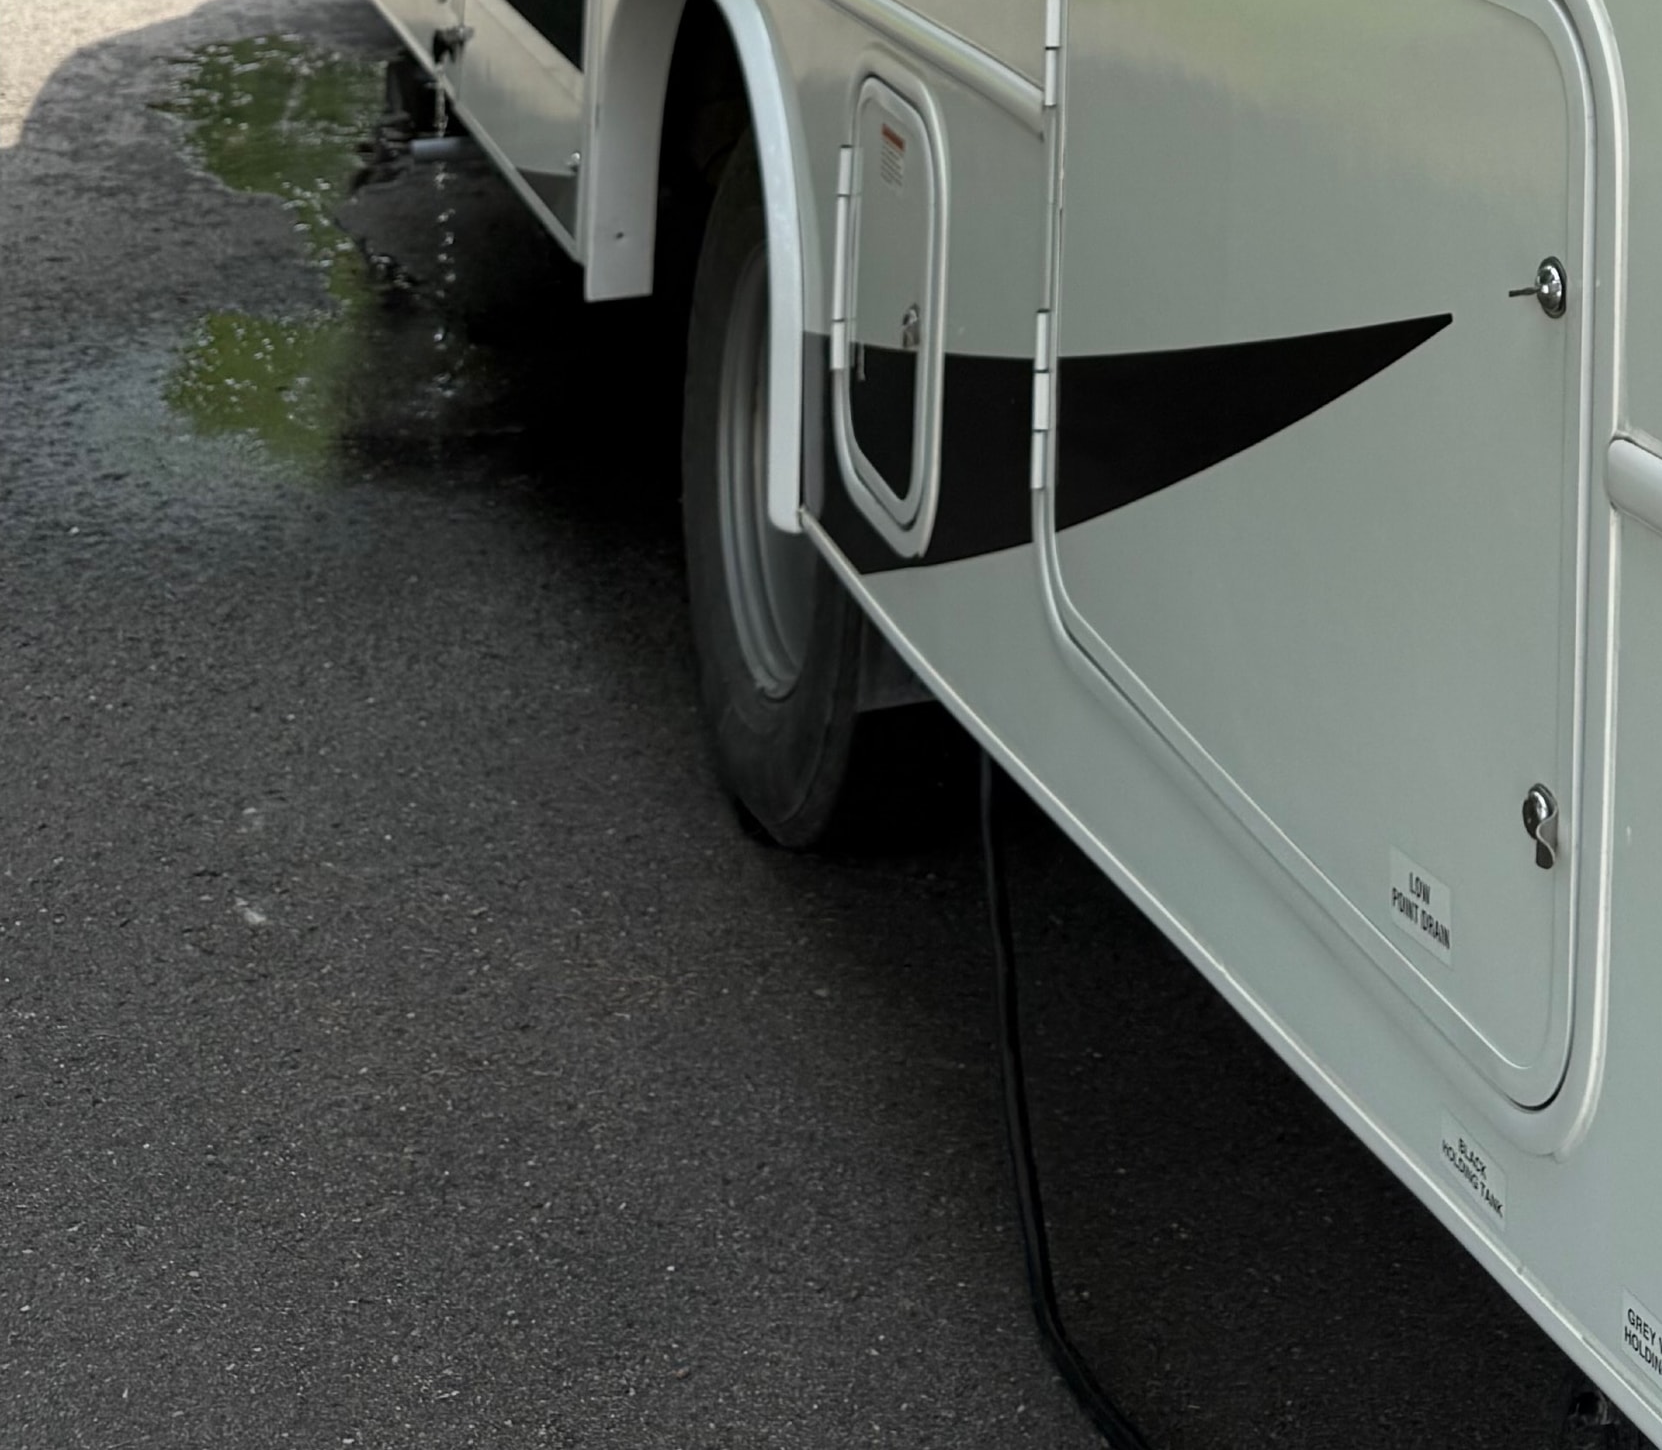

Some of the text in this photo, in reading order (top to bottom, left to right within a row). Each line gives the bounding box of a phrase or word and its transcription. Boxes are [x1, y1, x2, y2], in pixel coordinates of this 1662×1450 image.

[1409, 872, 1430, 905] LOW
[1392, 887, 1450, 949] POINT DRAIN
[1442, 1140, 1503, 1218] HOLDING TANK
[1459, 1138, 1487, 1180] BLACK
[1627, 1308, 1656, 1345] GREY
